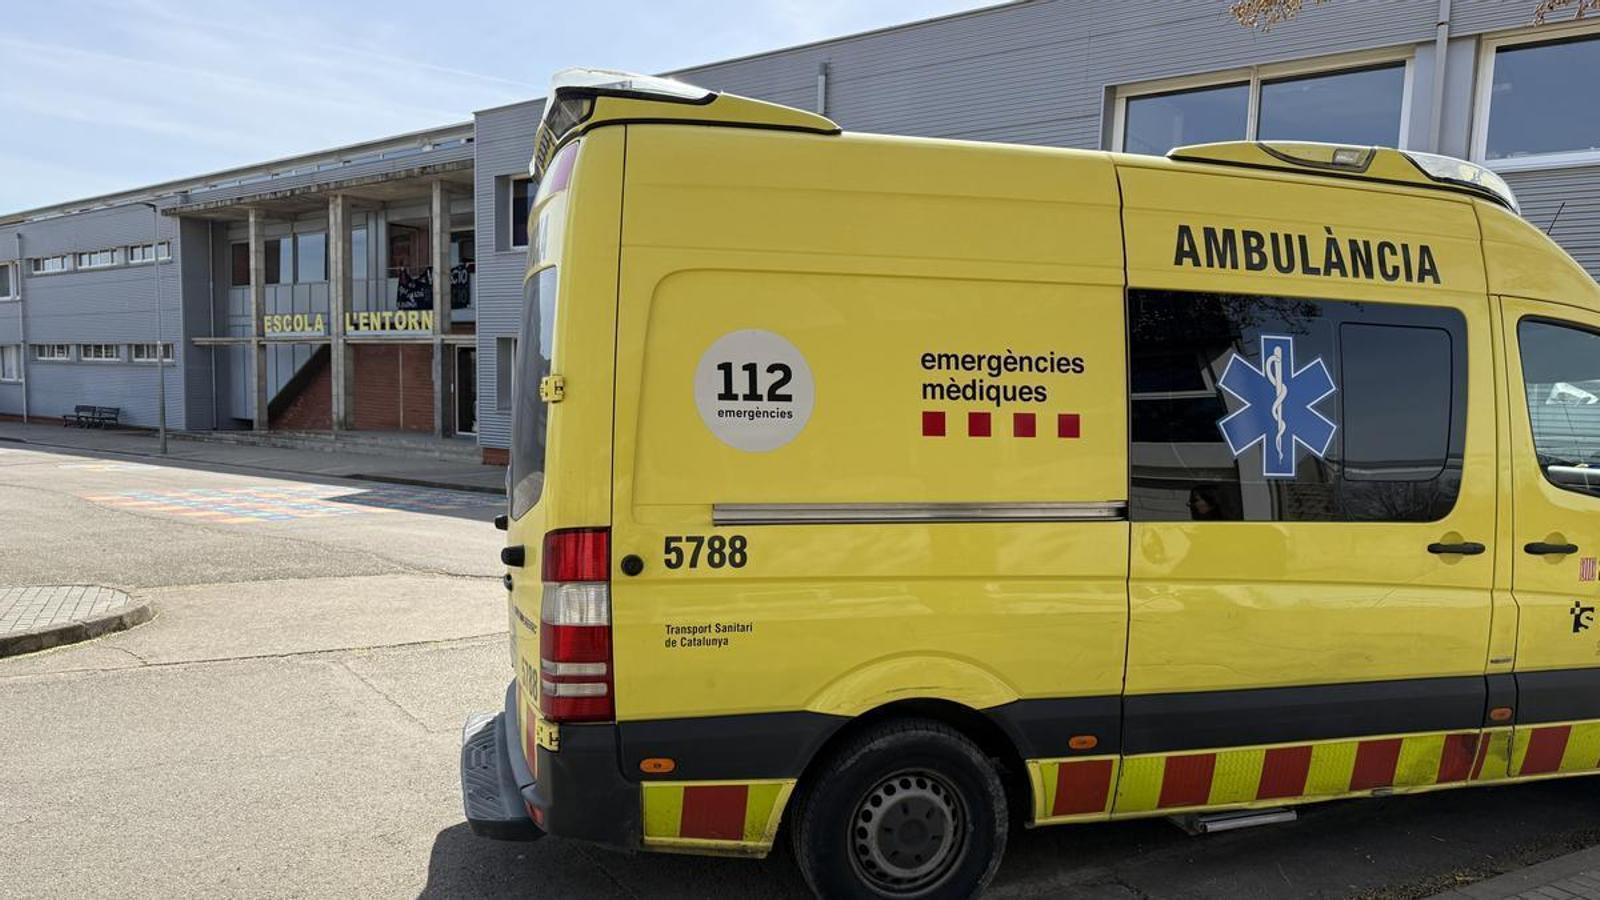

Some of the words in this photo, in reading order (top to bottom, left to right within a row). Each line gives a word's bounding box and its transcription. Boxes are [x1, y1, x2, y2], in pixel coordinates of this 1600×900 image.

[1174, 225, 1441, 285] AMBULÀNCIA
[264, 313, 325, 333] ESCOLA
[345, 310, 433, 332] L'ENTORN
[920, 349, 1085, 378] emergències
[717, 361, 793, 402] 112
[921, 377, 1048, 407] mèdiques
[717, 406, 793, 421] emergències
[663, 534, 748, 570] 5788
[664, 623, 712, 635] Transport
[715, 622, 753, 634] Sanitari
[664, 638, 677, 648] de
[680, 636, 729, 648] Catalunya
